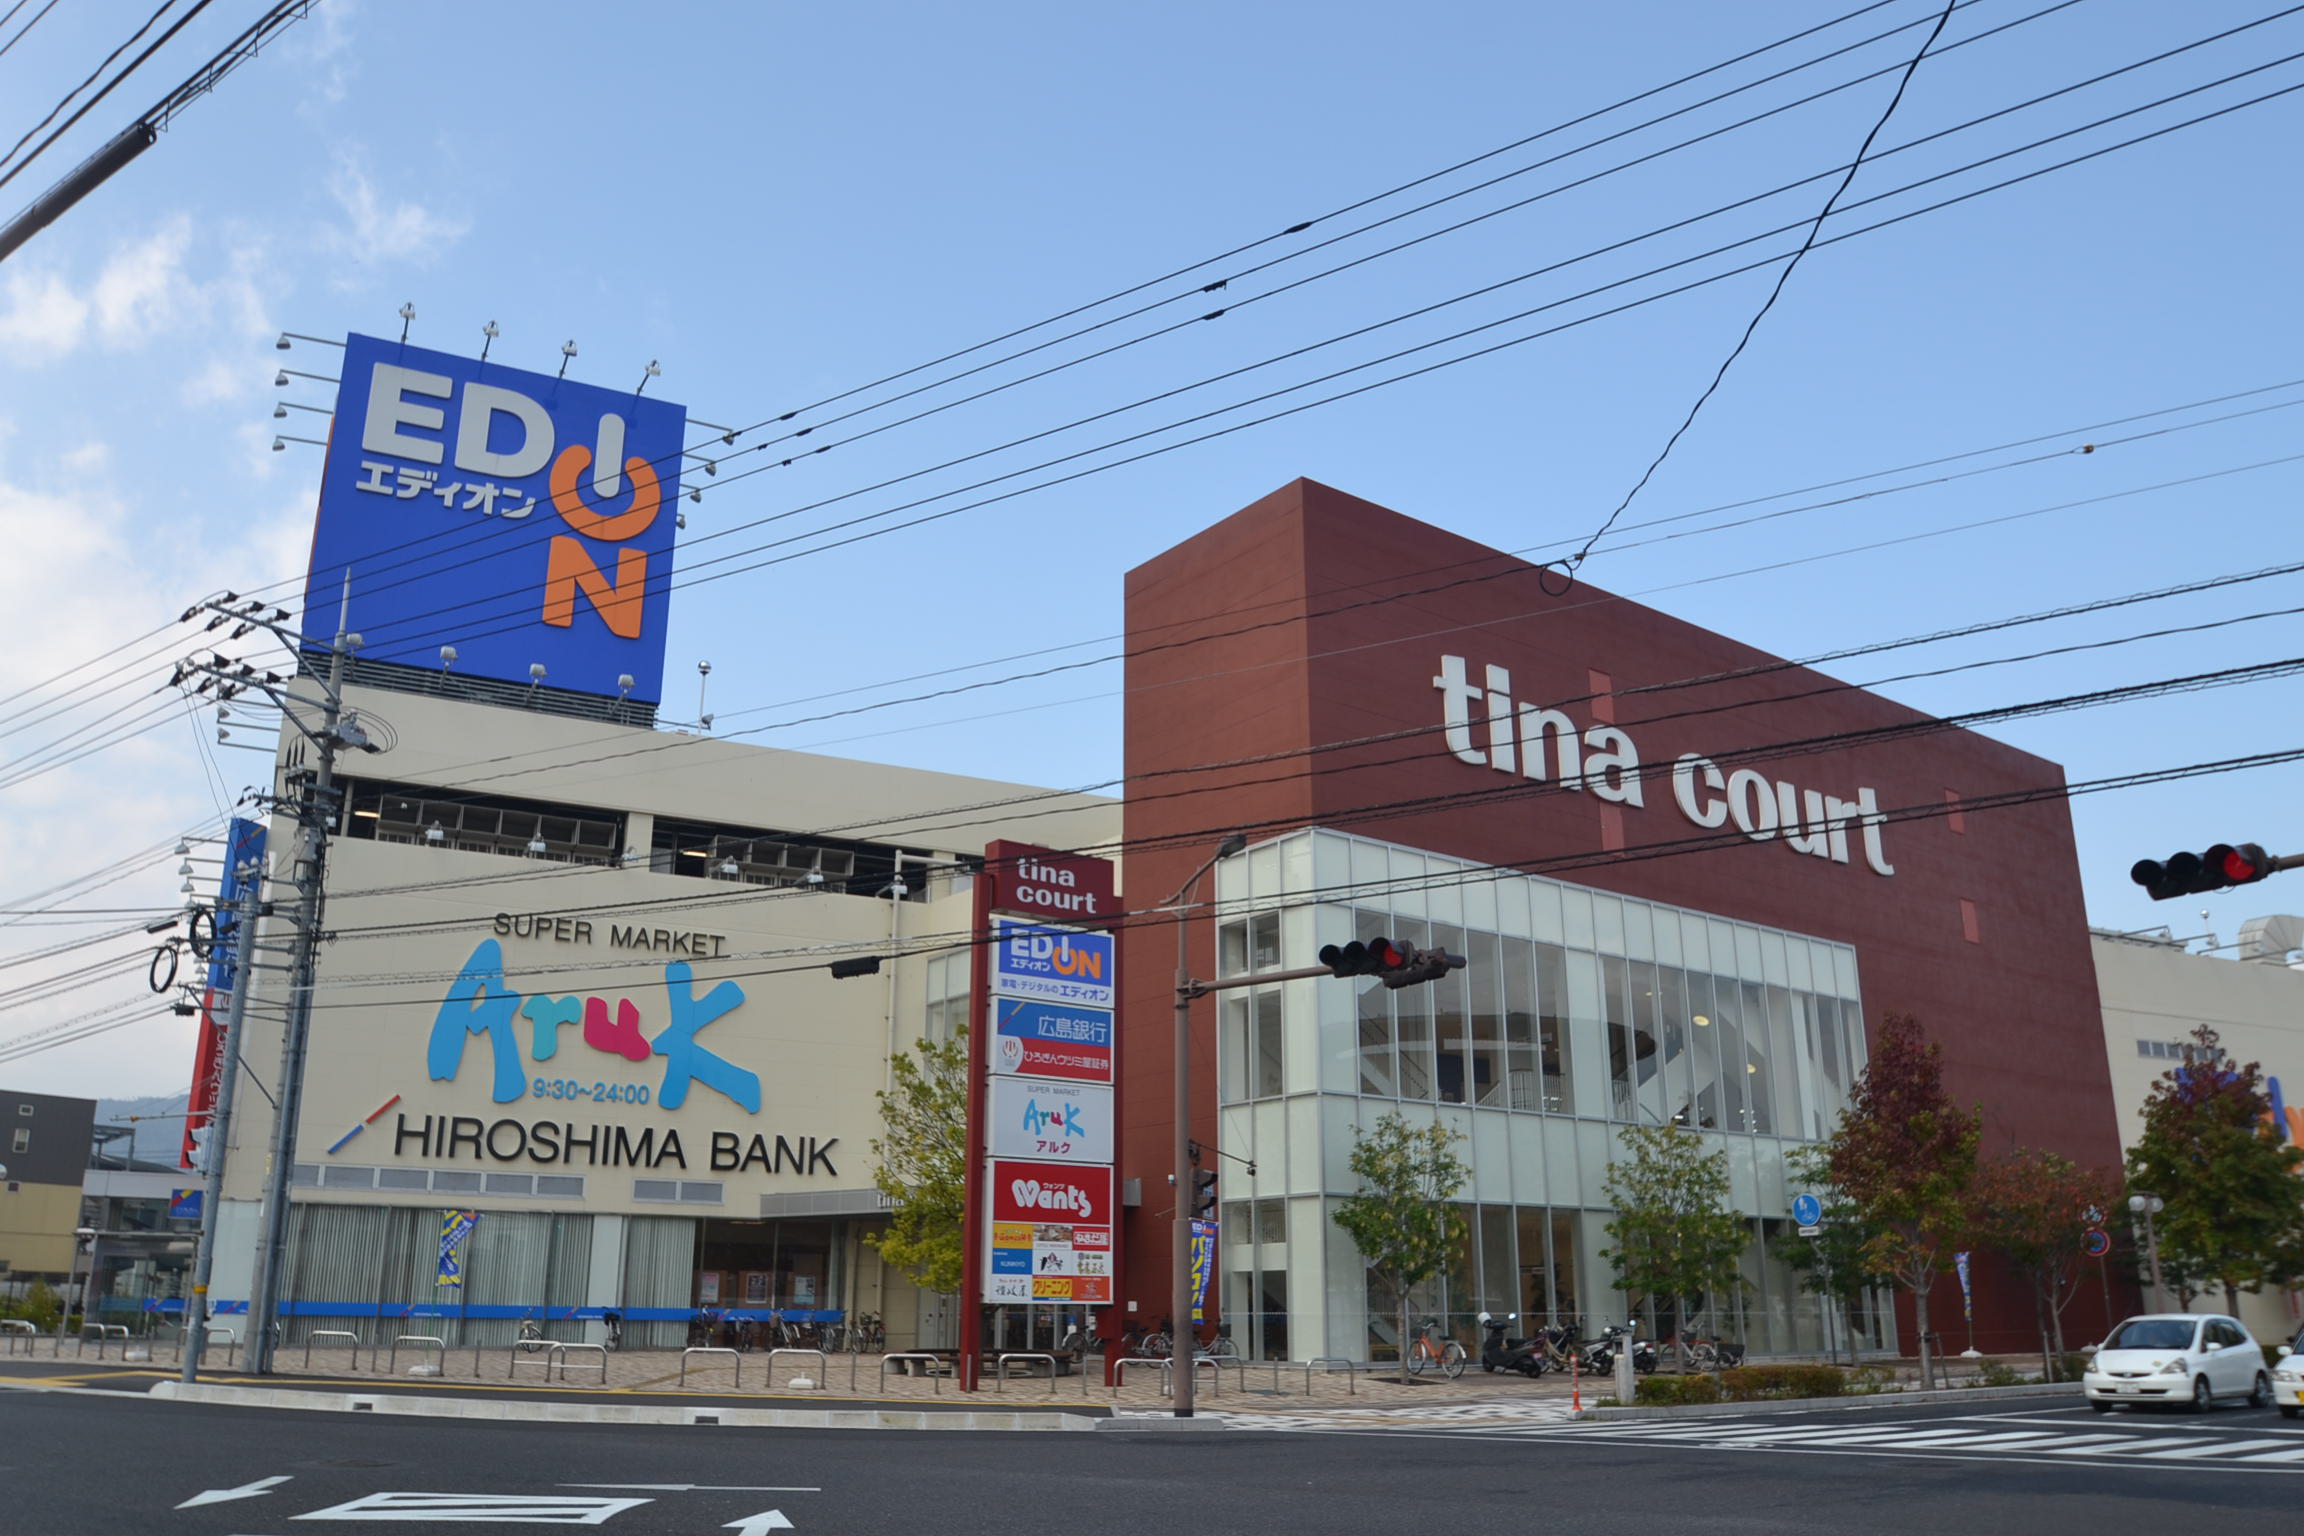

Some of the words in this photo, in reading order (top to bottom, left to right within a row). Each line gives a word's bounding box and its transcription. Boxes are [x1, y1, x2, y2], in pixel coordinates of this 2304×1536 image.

[355, 460, 536, 519] エディオン
[361, 361, 661, 640] EDION
[1432, 654, 1646, 809] tina
[1672, 753, 1895, 877] court
[1016, 856, 1075, 887] tina
[1016, 885, 1097, 914] court
[493, 912, 592, 945] SUPER
[610, 924, 726, 958] MARKET
[1010, 928, 1101, 979] EDION
[1010, 958, 1051, 972] エディオン
[1037, 1016, 1107, 1043] 広島銀行
[1027, 1085, 1050, 1094] SUPER
[1053, 1087, 1081, 1097] MARKET
[393, 1113, 687, 1170] HIROSHIMA
[710, 1131, 839, 1176] BANK
[1035, 1140, 1071, 1154] アルク
[1012, 1179, 1092, 1218] Wants
